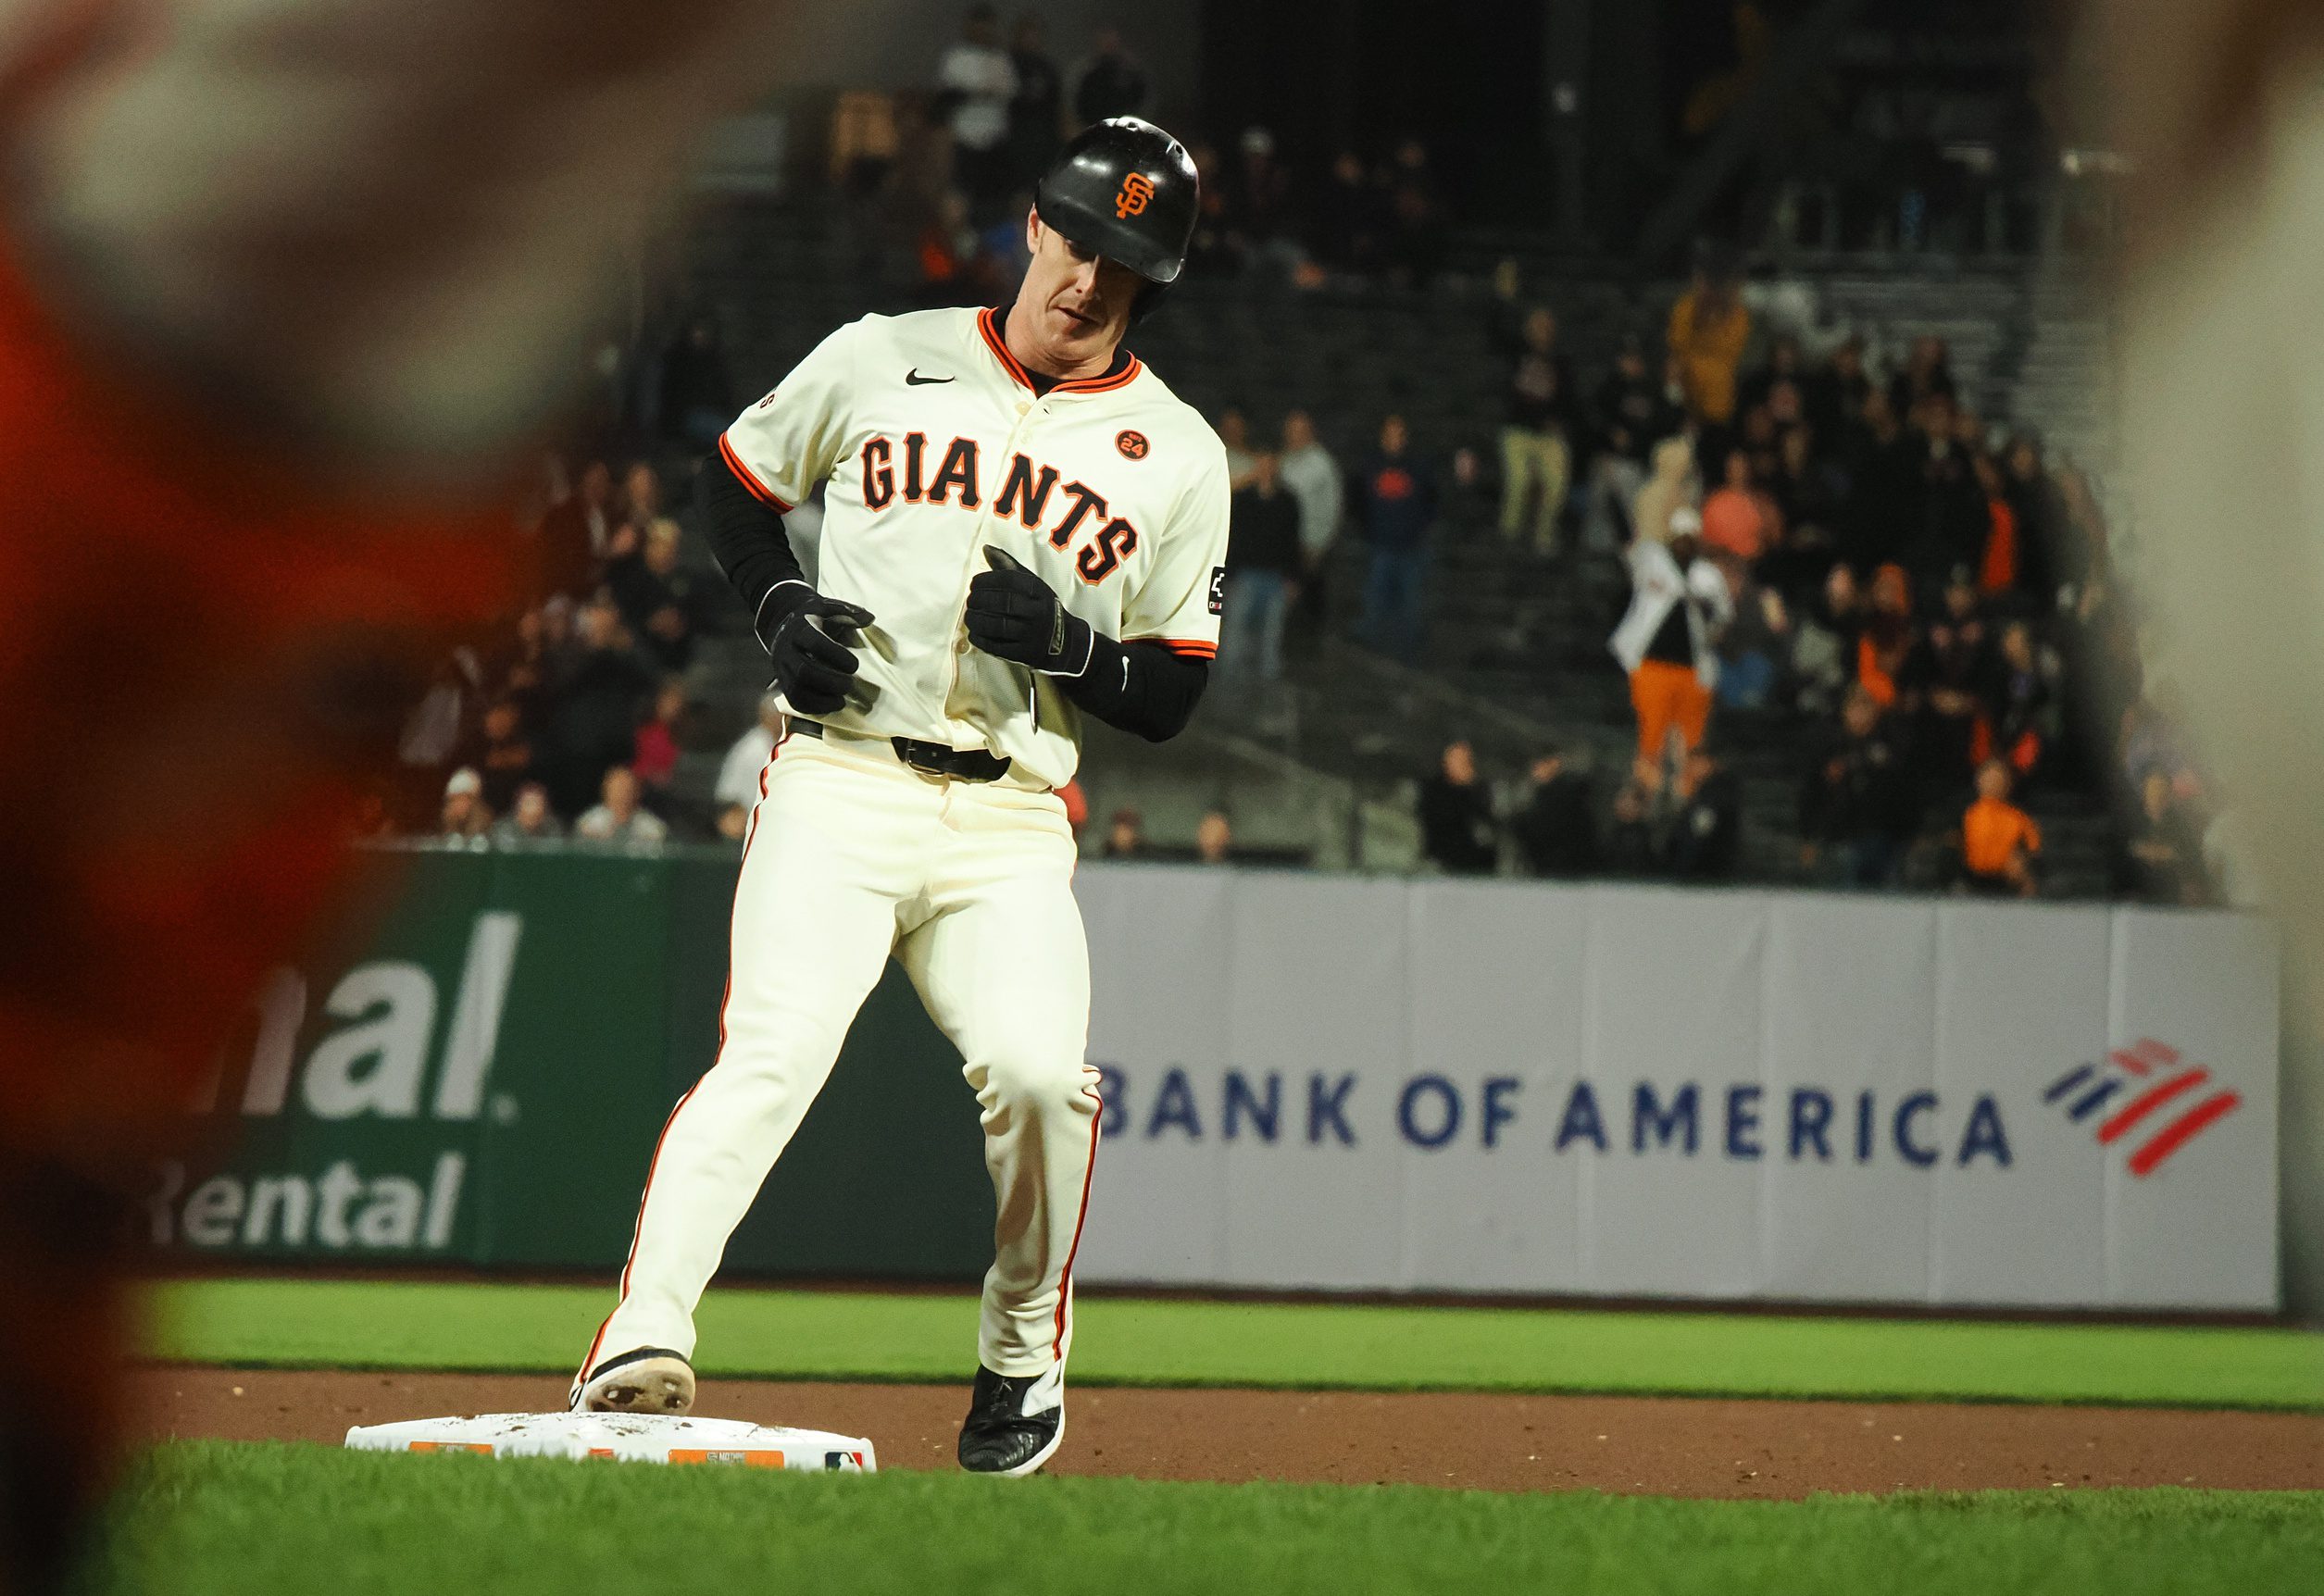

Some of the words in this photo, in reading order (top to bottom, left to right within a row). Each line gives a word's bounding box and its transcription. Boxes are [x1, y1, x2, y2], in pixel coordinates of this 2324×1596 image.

[1120, 437, 1143, 456] 24
[860, 431, 1138, 586] GIANTS
[1098, 1062, 1356, 1150] BANK
[1396, 1071, 1524, 1152] OF
[1553, 1078, 2015, 1168] AMERICA
